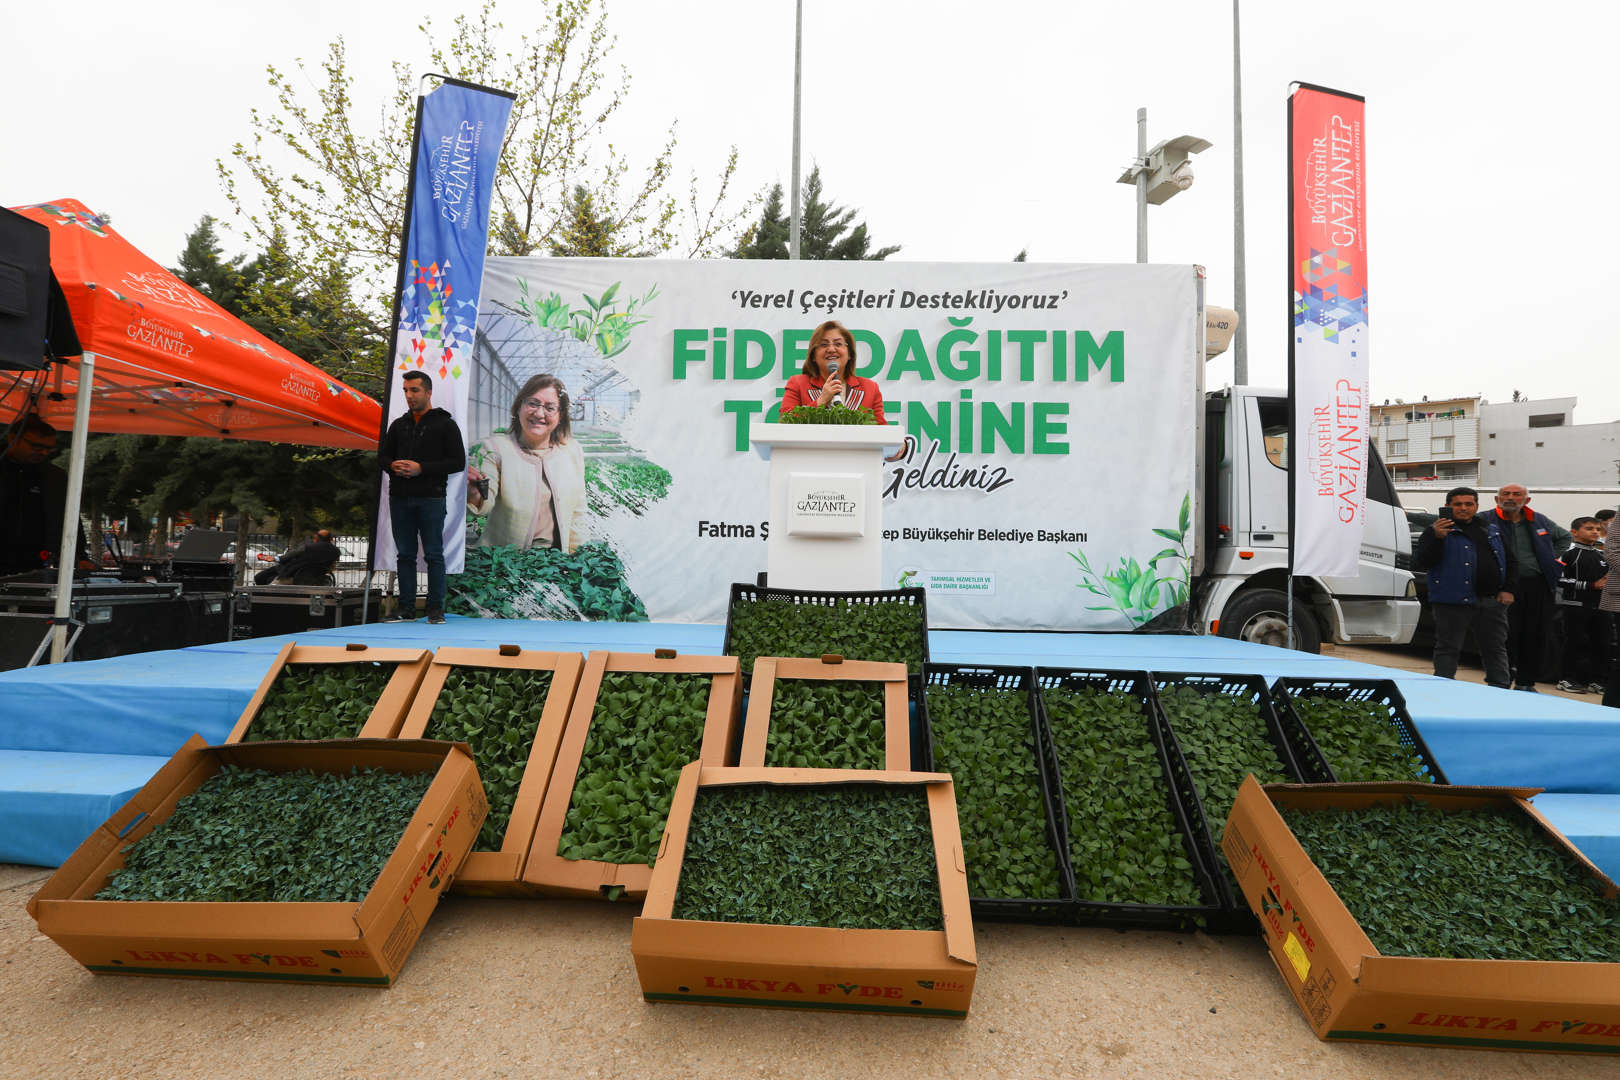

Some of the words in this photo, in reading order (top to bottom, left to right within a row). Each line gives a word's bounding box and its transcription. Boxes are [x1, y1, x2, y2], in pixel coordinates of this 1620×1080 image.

[1312, 138, 1329, 224] BÜYÜKŞEHİR
[1328, 115, 1356, 246] GAZİANTEP
[799, 289, 896, 314] Çeşitleri
[854, 316, 1125, 383] DAĞITIM
[1314, 404, 1335, 496] BÜYÜKŞEHİR
[1334, 379, 1361, 523] GAZİANTEP
[698, 520, 755, 538] Fatma
[902, 527, 975, 543] Büyükşehir
[977, 528, 1034, 544] Belediye
[1037, 528, 1088, 544] Başkanı
